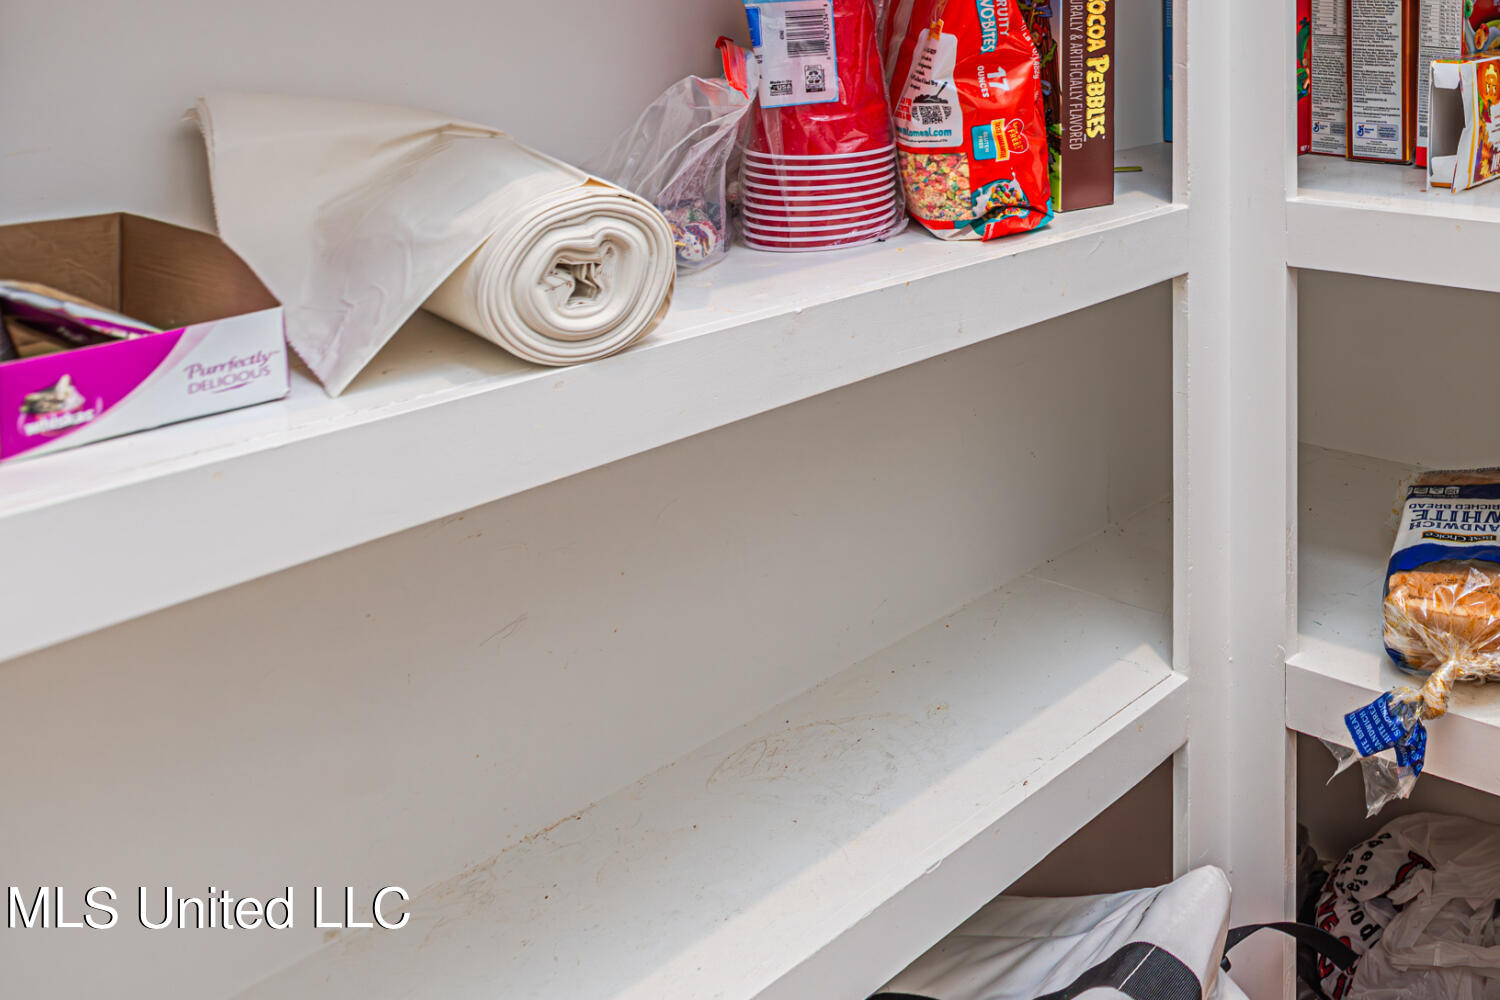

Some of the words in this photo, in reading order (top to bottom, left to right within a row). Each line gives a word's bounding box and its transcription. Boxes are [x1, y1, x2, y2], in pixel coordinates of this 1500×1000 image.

[977, 65, 989, 99] OUNCES
[987, 65, 1009, 94] 17
[1069, 40, 1084, 93] ARTIFICIALLY
[1086, 52, 1111, 139] PEBBLES
[1069, 95, 1084, 151] FLAVORED
[187, 365, 271, 394] DELICIOUS
